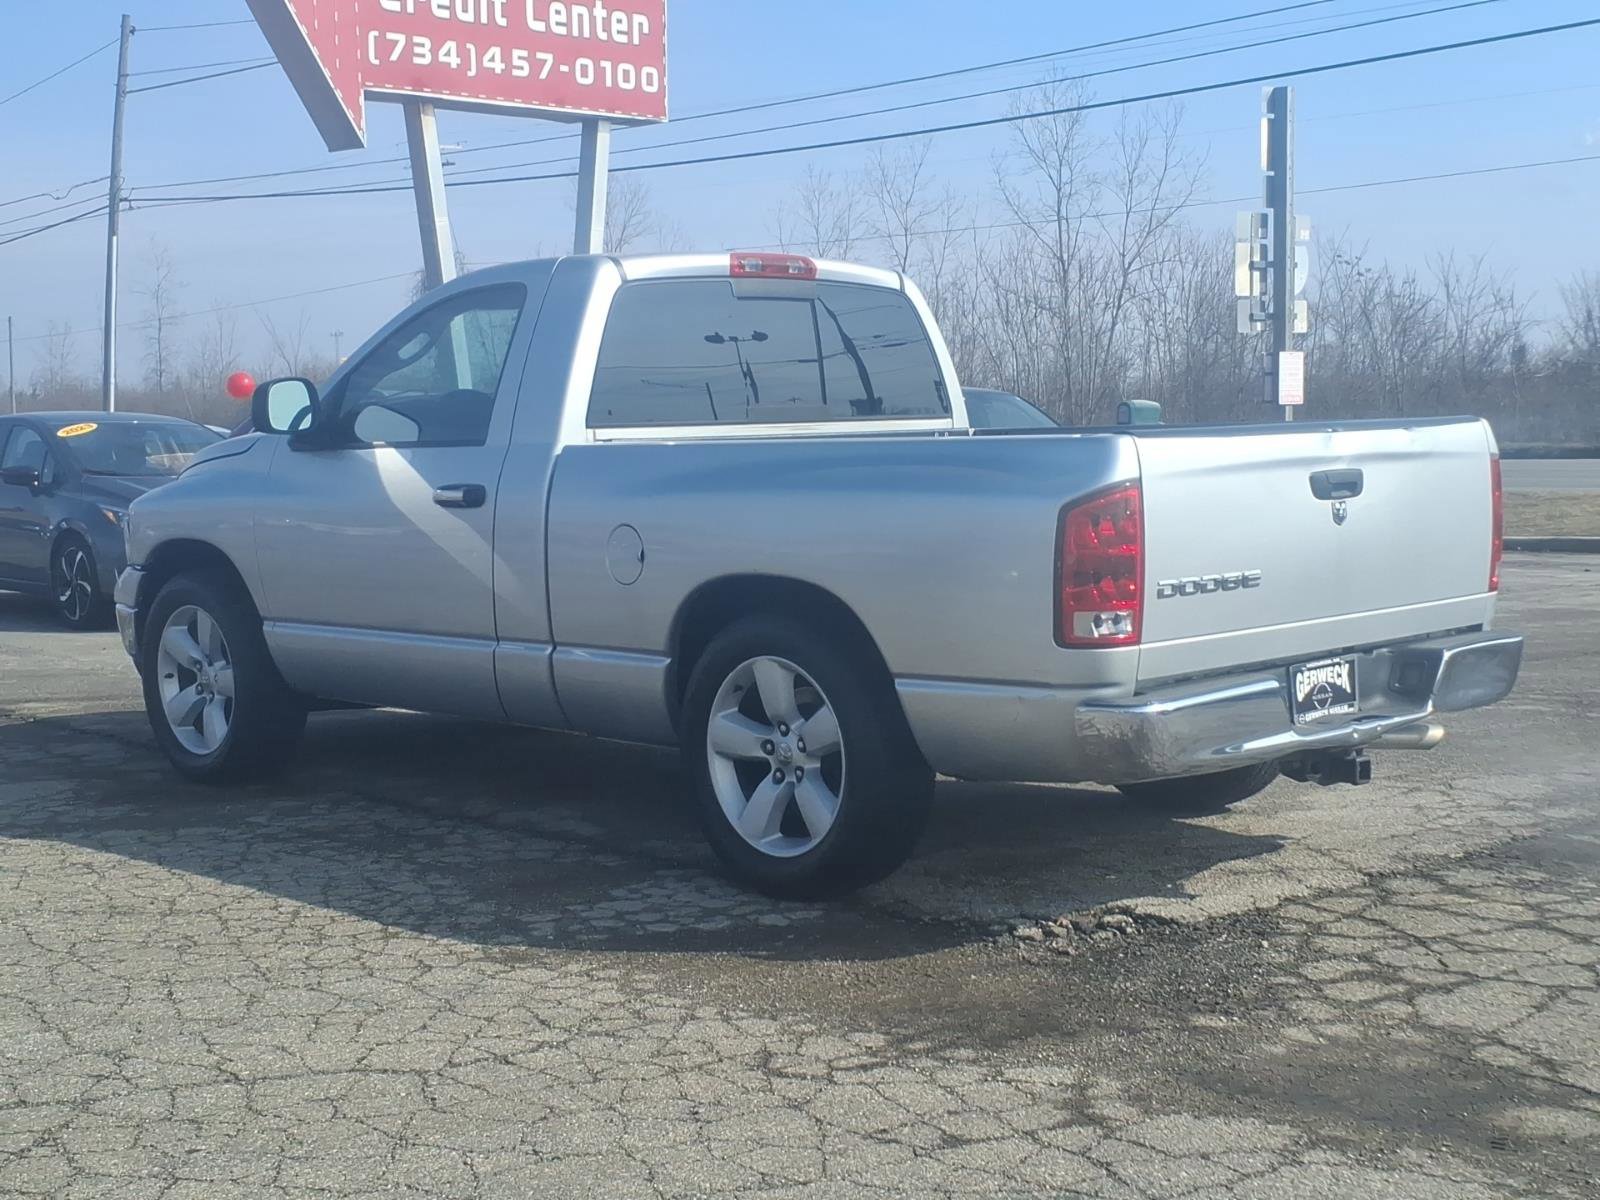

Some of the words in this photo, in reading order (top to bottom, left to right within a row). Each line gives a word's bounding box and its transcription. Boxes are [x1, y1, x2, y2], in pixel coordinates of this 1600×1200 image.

[380, 0, 507, 27] edit
[526, 0, 649, 45] Center
[368, 30, 660, 93] (734)457-0100
[1157, 569, 1261, 599] DODGE
[1296, 663, 1351, 702] GERWECK
